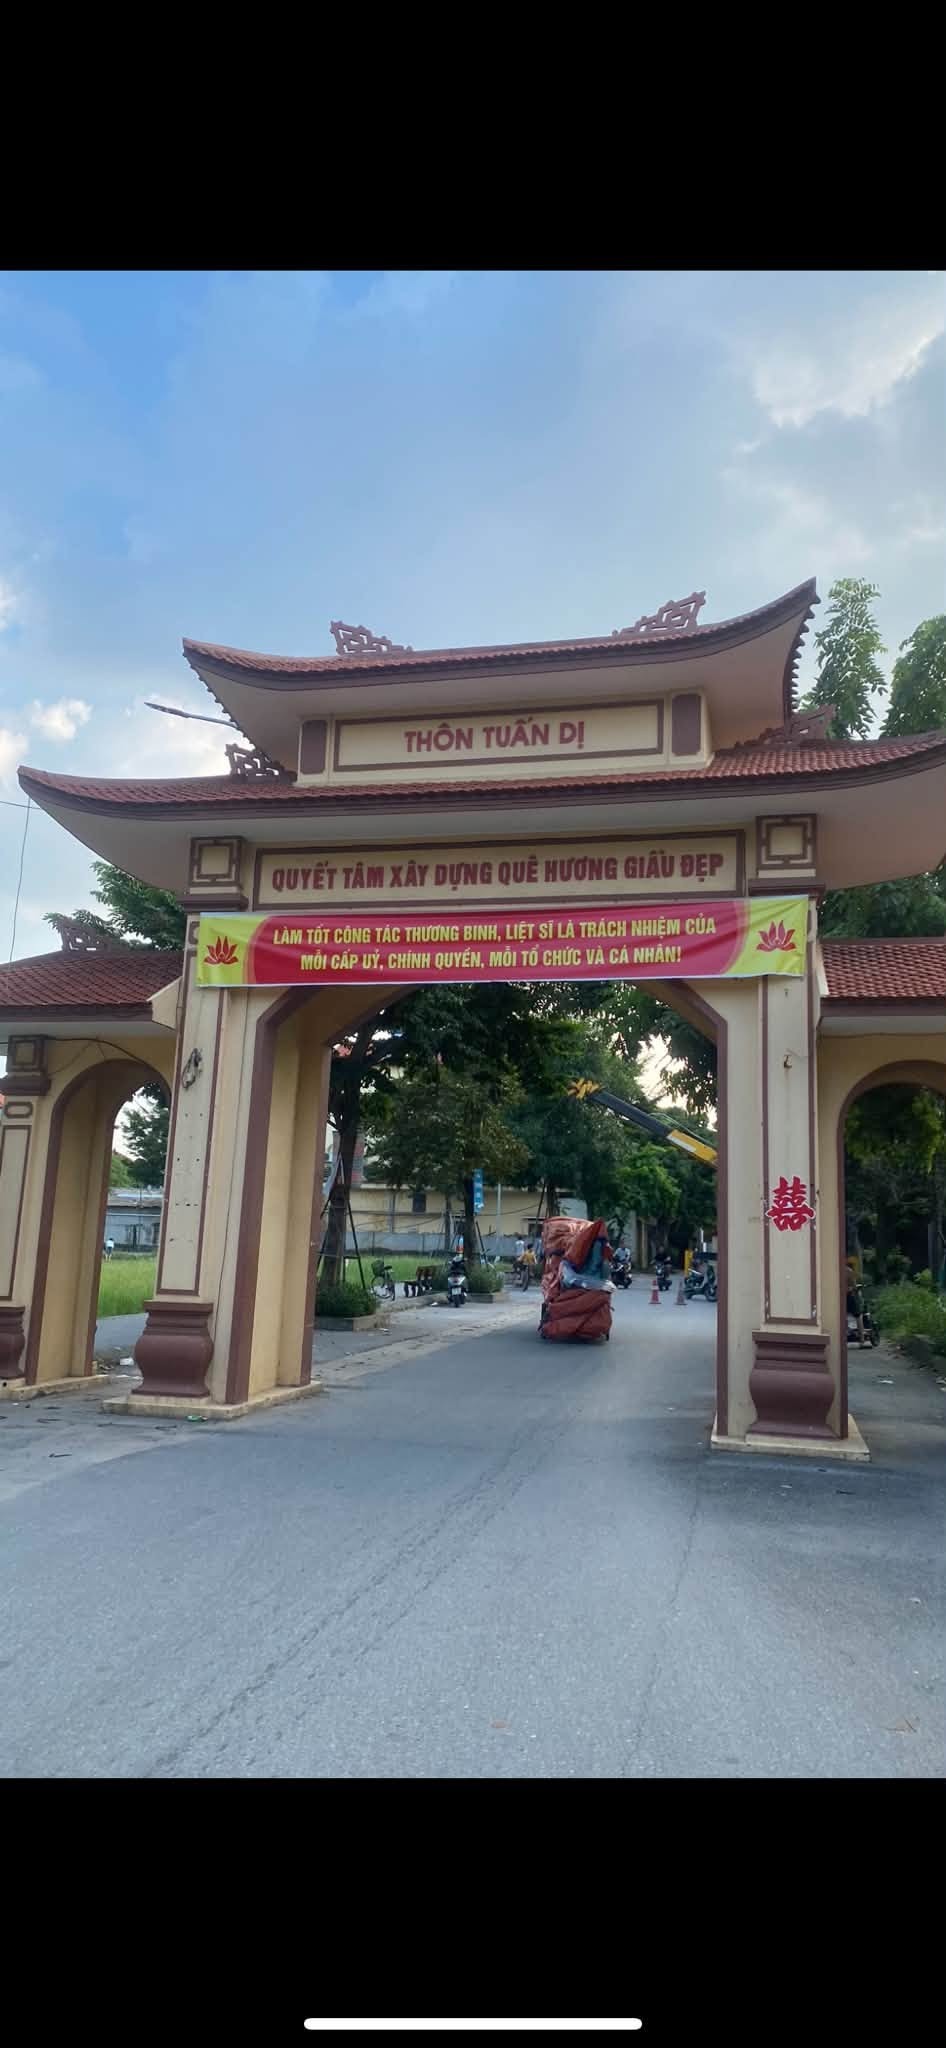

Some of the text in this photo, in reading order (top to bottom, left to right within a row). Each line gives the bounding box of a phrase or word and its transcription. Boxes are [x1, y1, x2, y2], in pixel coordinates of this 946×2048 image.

[404, 717, 584, 752] THÔN TUẤN DỊ
[272, 861, 337, 891] QUYẾT
[343, 862, 385, 889] TÂM
[390, 860, 429, 887] XÂY
[434, 861, 492, 891] DỰNG
[498, 854, 538, 885] QUÊ
[544, 856, 617, 882] HƯƠNG
[680, 853, 724, 882] ĐẸP
[273, 912, 717, 945] LÀM TỐT CÔNG TÁC THƯƠNG BINH, LIỆT SĨ LÀ TRÁCH NHIỆM CỦA
[331, 948, 358, 969] CẤP
[388, 950, 431, 969] CHÍNH
[543, 945, 582, 966] CHỨC
[586, 944, 605, 965] VÀ
[609, 946, 630, 964] CÁ
[633, 943, 682, 963] NHÂN!
